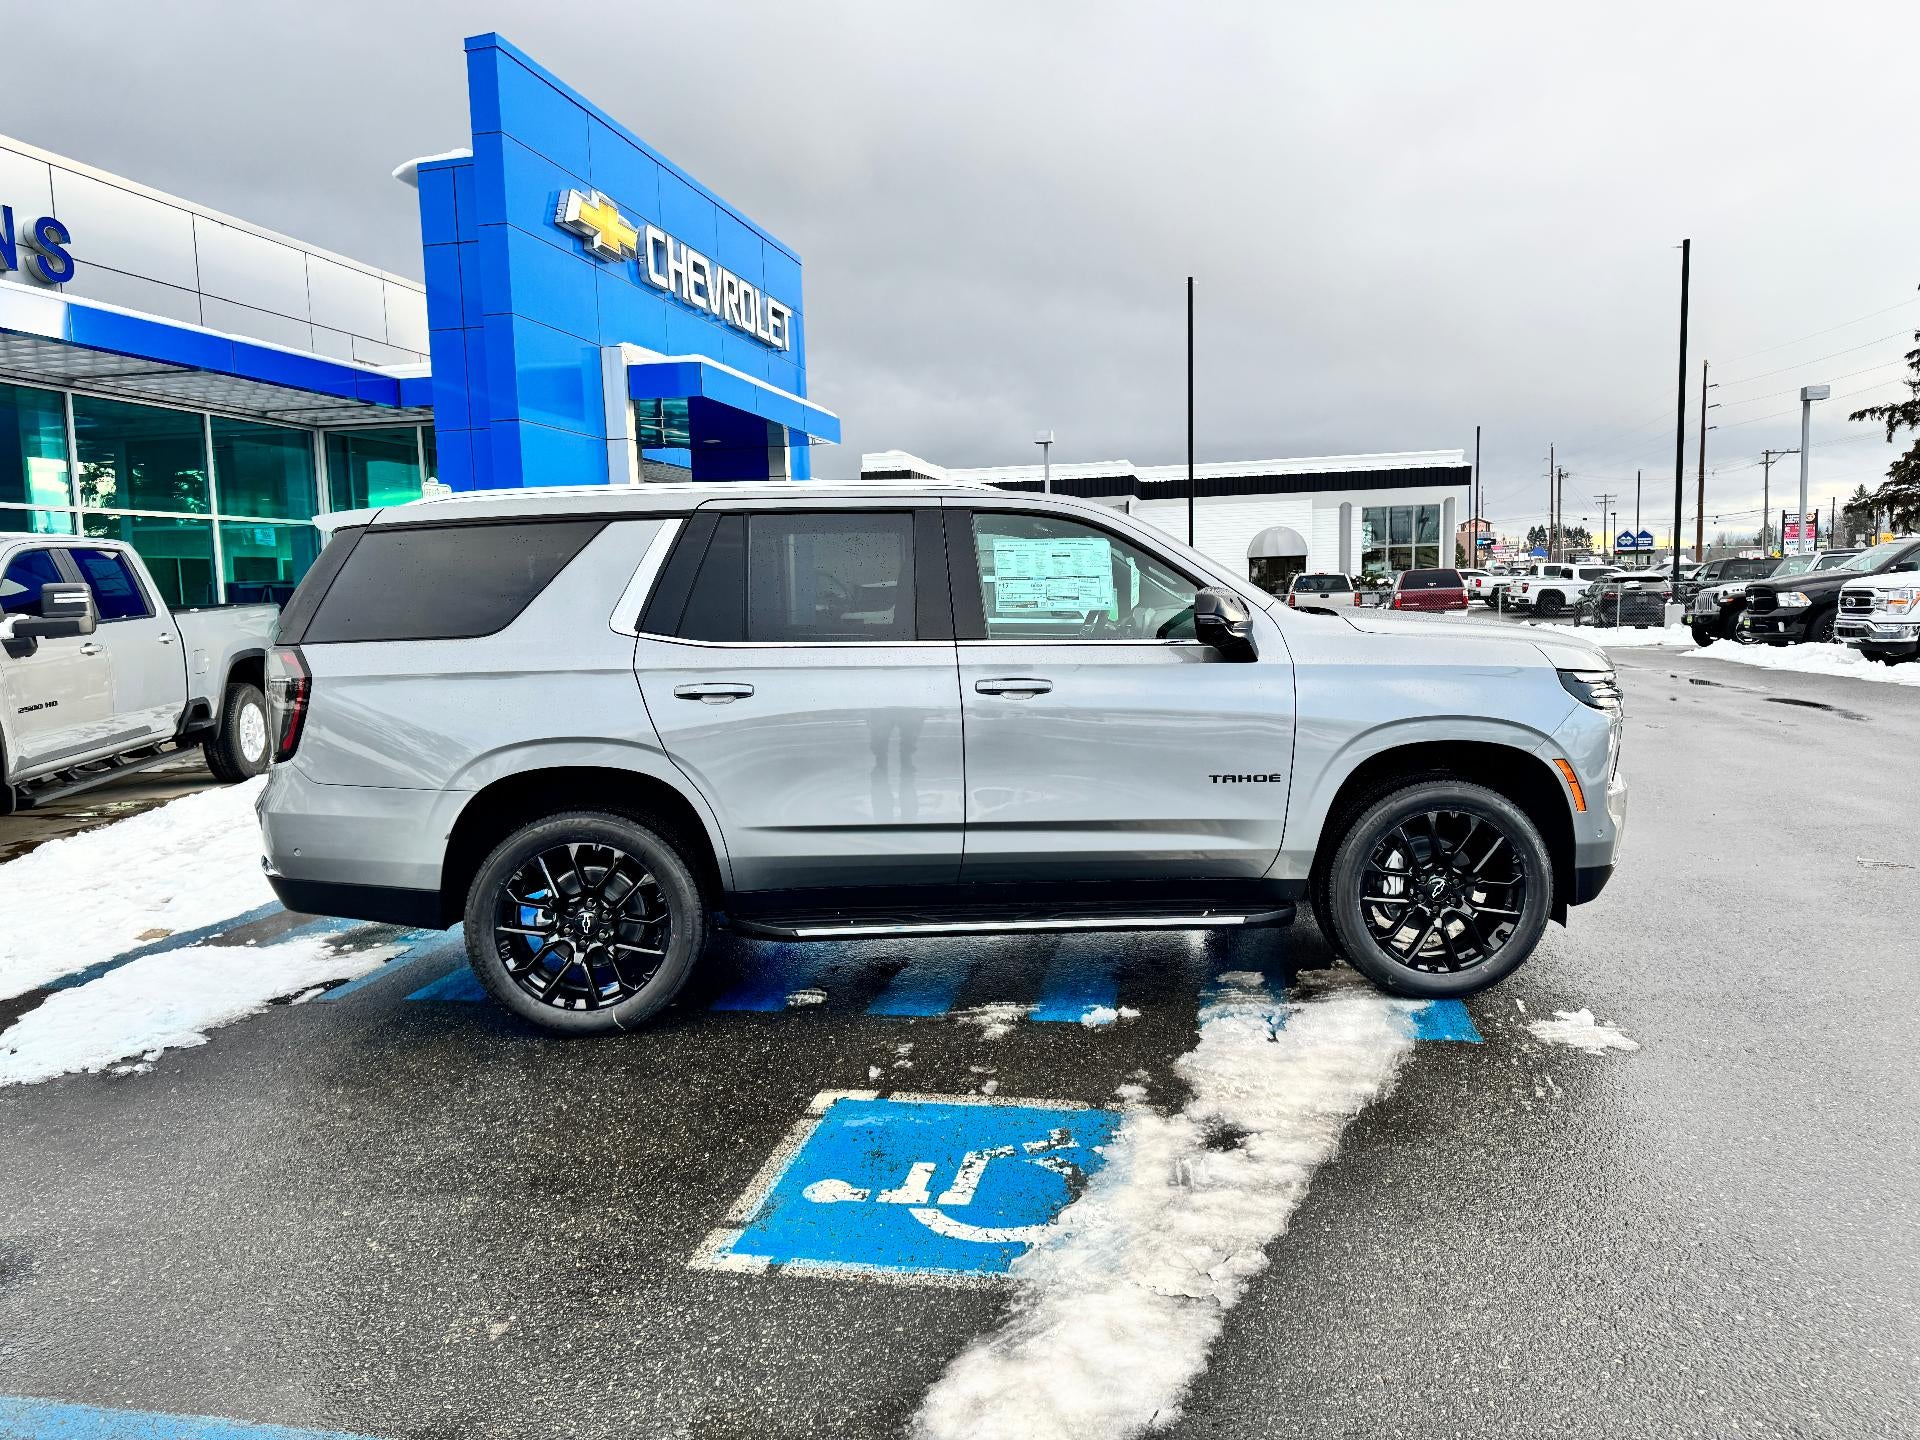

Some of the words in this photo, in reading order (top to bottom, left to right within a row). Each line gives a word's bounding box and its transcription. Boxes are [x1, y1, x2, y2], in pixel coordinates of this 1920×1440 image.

[638, 225, 792, 351] CHEVROLET
[18, 703, 43, 714] 2500
[45, 700, 58, 708] HD
[1208, 773, 1281, 783] TAHOE
